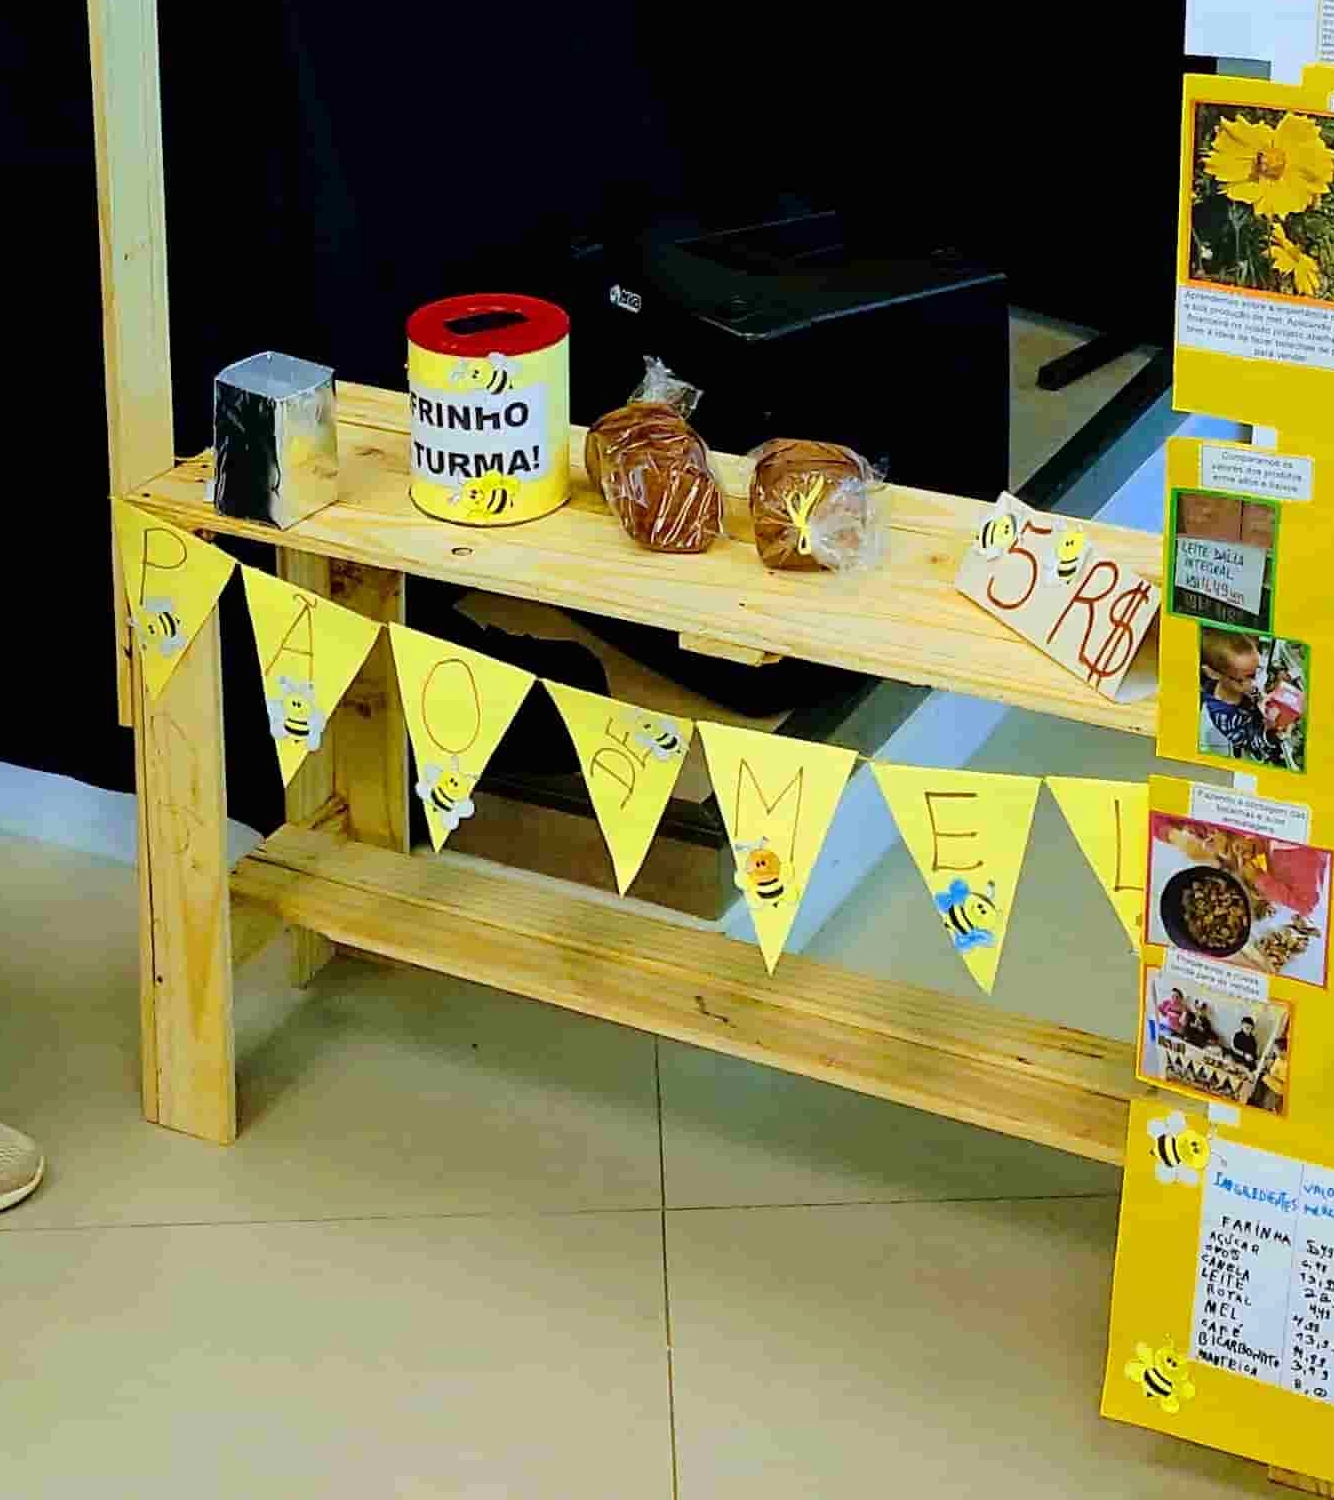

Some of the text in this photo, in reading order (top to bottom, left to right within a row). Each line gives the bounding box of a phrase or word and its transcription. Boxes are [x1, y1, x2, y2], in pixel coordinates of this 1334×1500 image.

[414, 440, 539, 478] TURMA!
[987, 520, 1152, 692] 5 R$
[1222, 1215, 1292, 1246] FARINHA
[1201, 1267, 1244, 1291] LEITE
[1204, 1299, 1237, 1320] MEL
